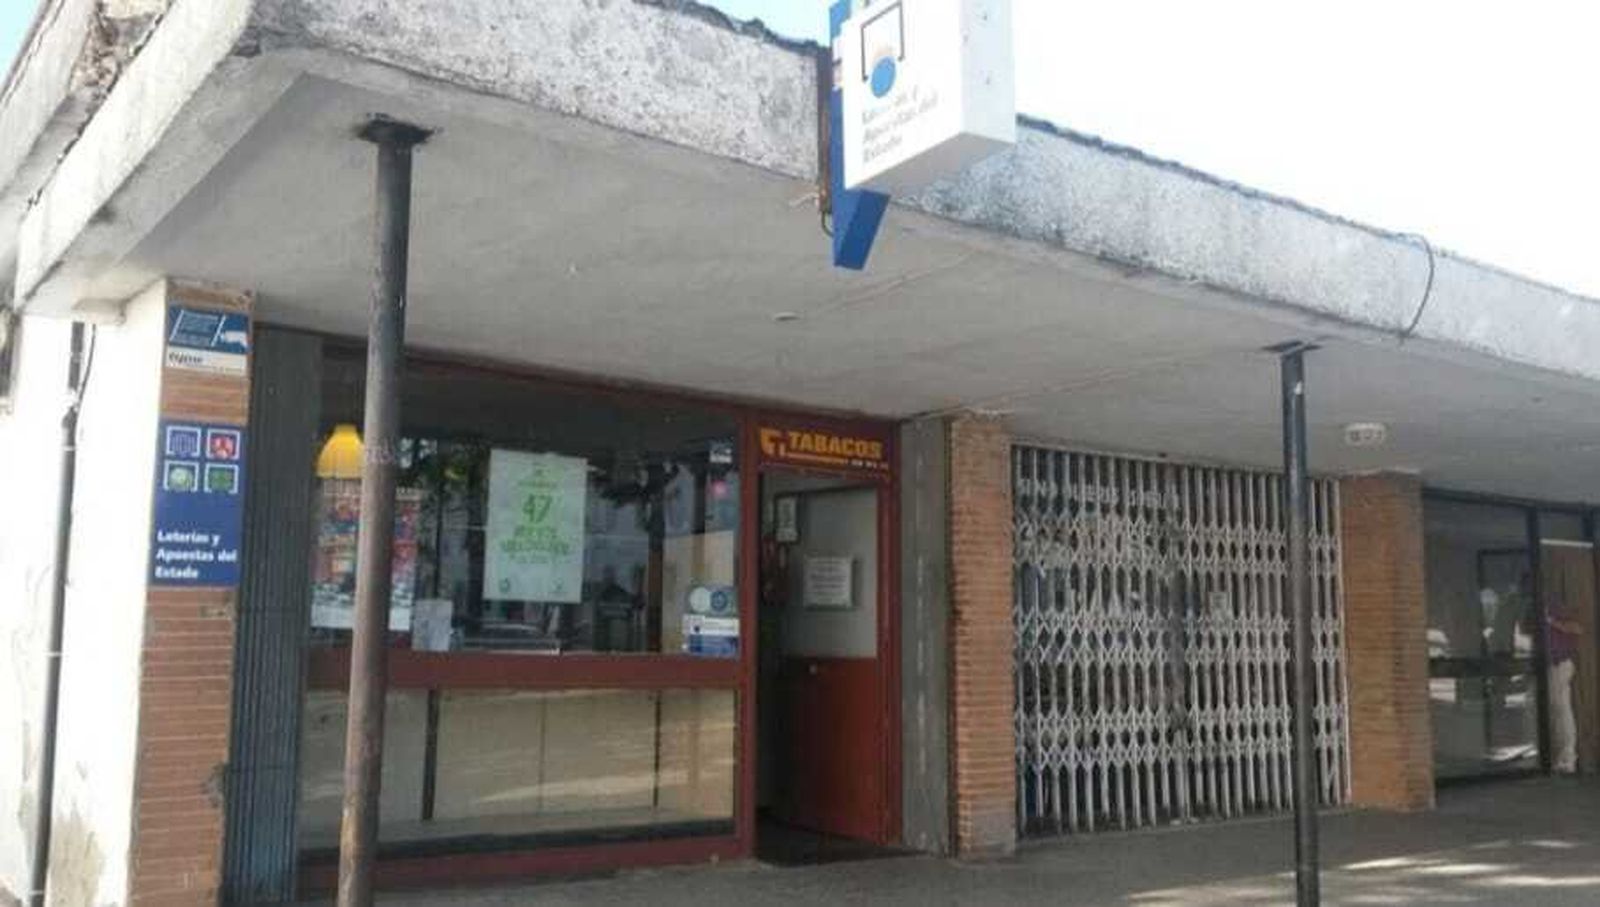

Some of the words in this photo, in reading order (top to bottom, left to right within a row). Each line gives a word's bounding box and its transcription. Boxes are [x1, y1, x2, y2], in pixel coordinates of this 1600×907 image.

[788, 430, 882, 460] TABACOS
[522, 494, 553, 523] 47
[211, 533, 221, 548] y
[155, 548, 215, 564] Apuestas
[154, 565, 199, 579] Estado
